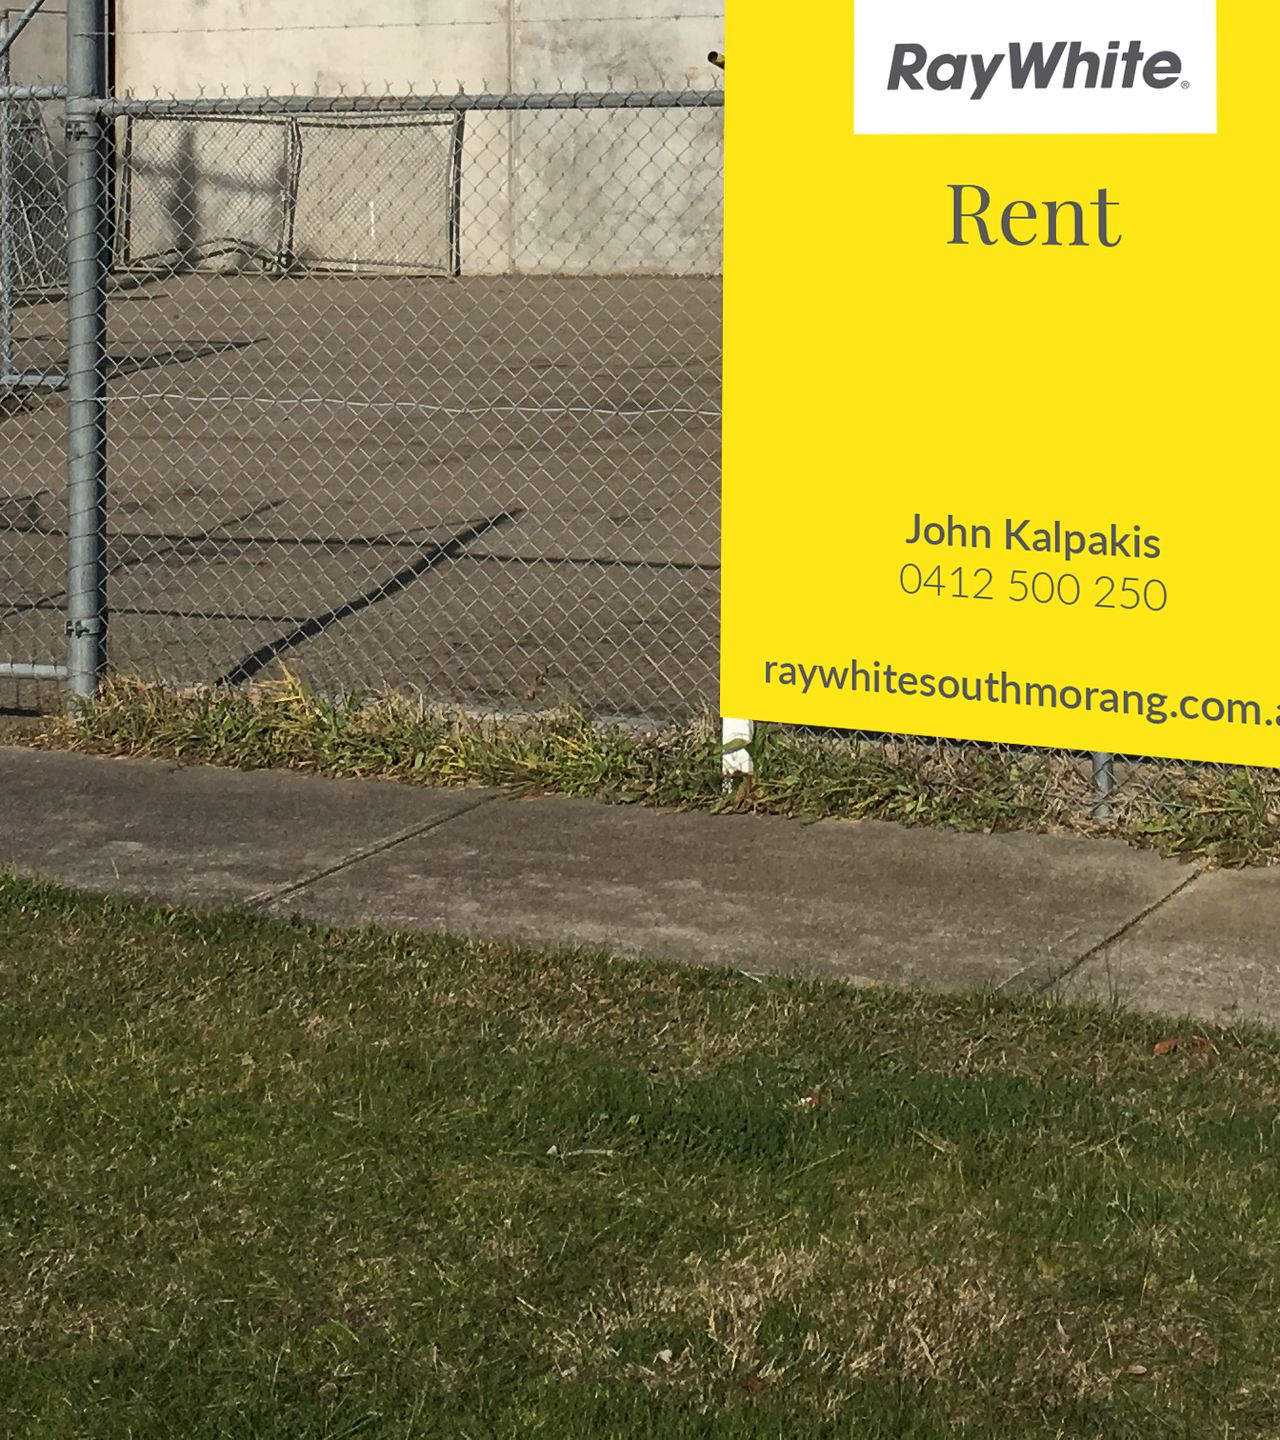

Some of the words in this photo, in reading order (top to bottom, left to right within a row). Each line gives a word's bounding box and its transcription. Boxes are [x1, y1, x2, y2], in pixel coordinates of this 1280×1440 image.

[946, 184, 1122, 248] Rent
[905, 513, 991, 549] John
[1005, 518, 1161, 561] Kalpakis
[900, 563, 993, 600] 0412
[1009, 570, 1080, 606] 500
[1094, 575, 1167, 612] 250
